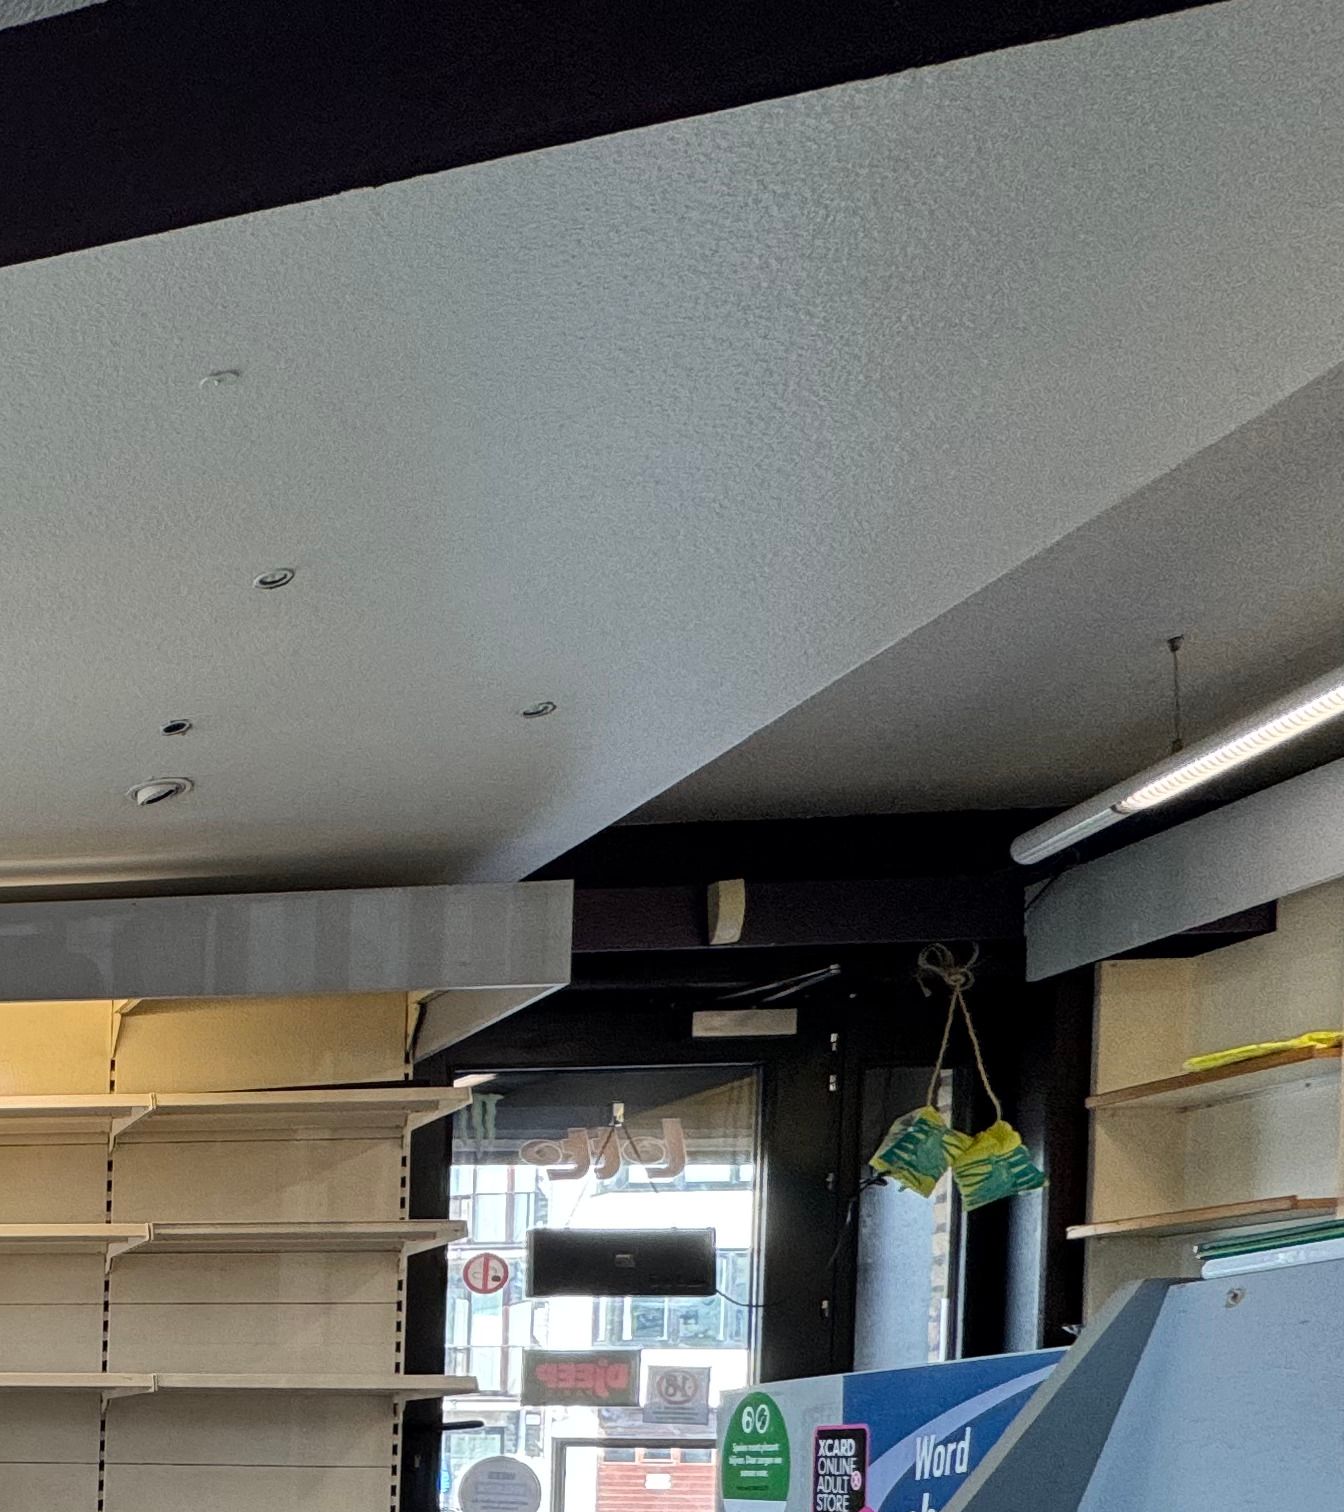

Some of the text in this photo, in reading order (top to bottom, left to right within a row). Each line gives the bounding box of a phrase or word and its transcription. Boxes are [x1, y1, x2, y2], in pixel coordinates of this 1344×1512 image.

[816, 1438, 856, 1457] XCARD
[914, 1427, 973, 1481] Word
[817, 1457, 859, 1476] ONLINE
[816, 1476, 851, 1494] ADULT
[815, 1494, 850, 1512] STORE
